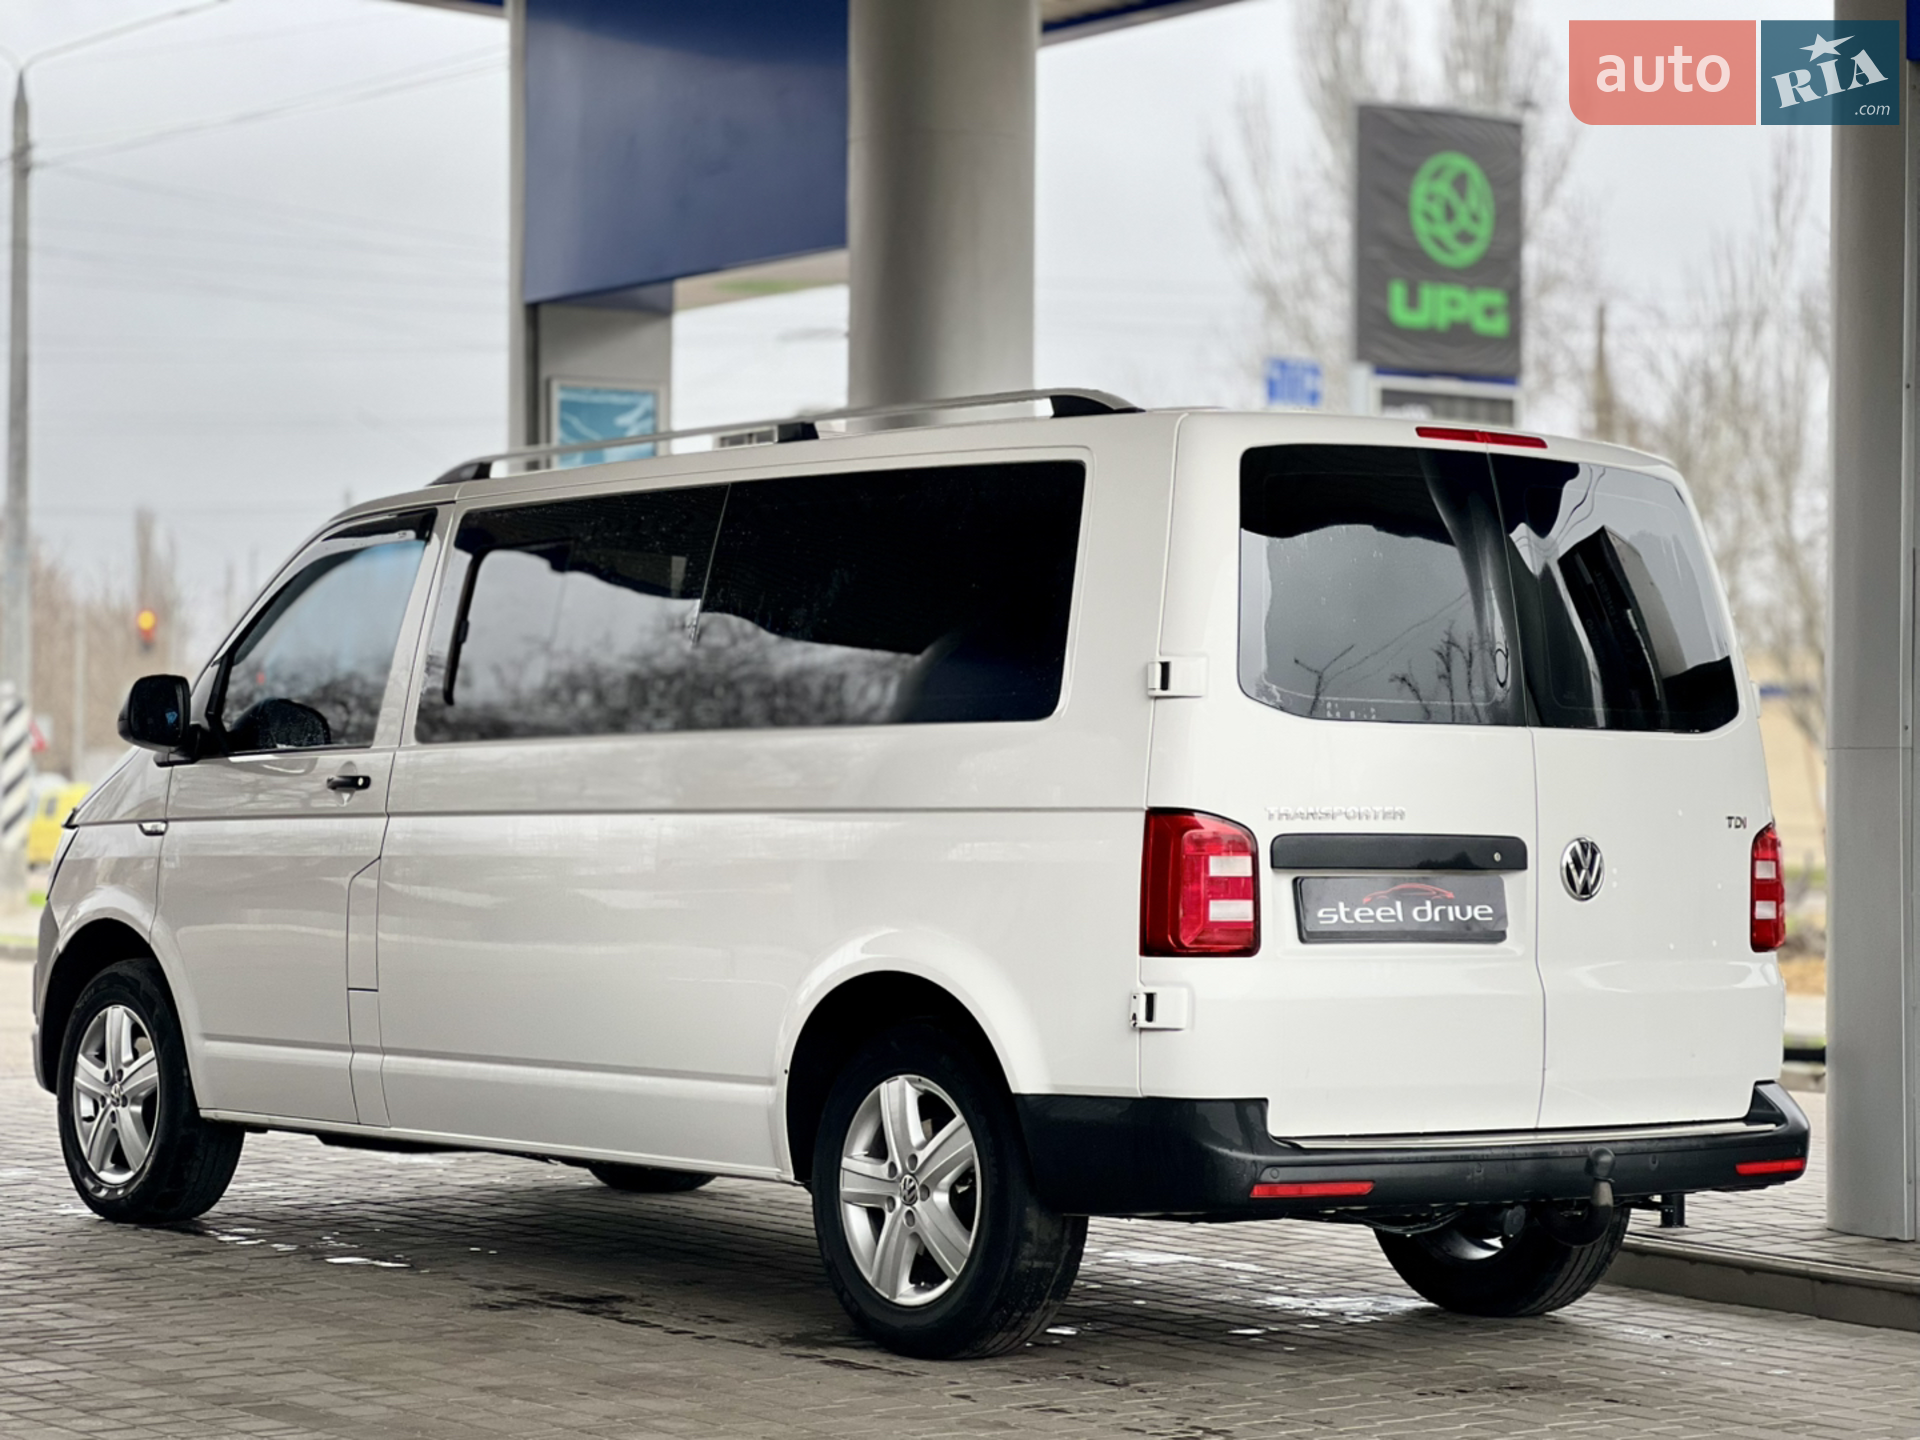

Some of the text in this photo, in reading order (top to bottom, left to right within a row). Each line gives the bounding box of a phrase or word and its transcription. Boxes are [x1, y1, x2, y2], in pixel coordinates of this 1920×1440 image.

[1387, 279, 1509, 337] UPG
[1265, 806, 1406, 821] TRANSPORTER
[1726, 815, 1748, 830] TDI
[1317, 900, 1494, 924] steel drive
